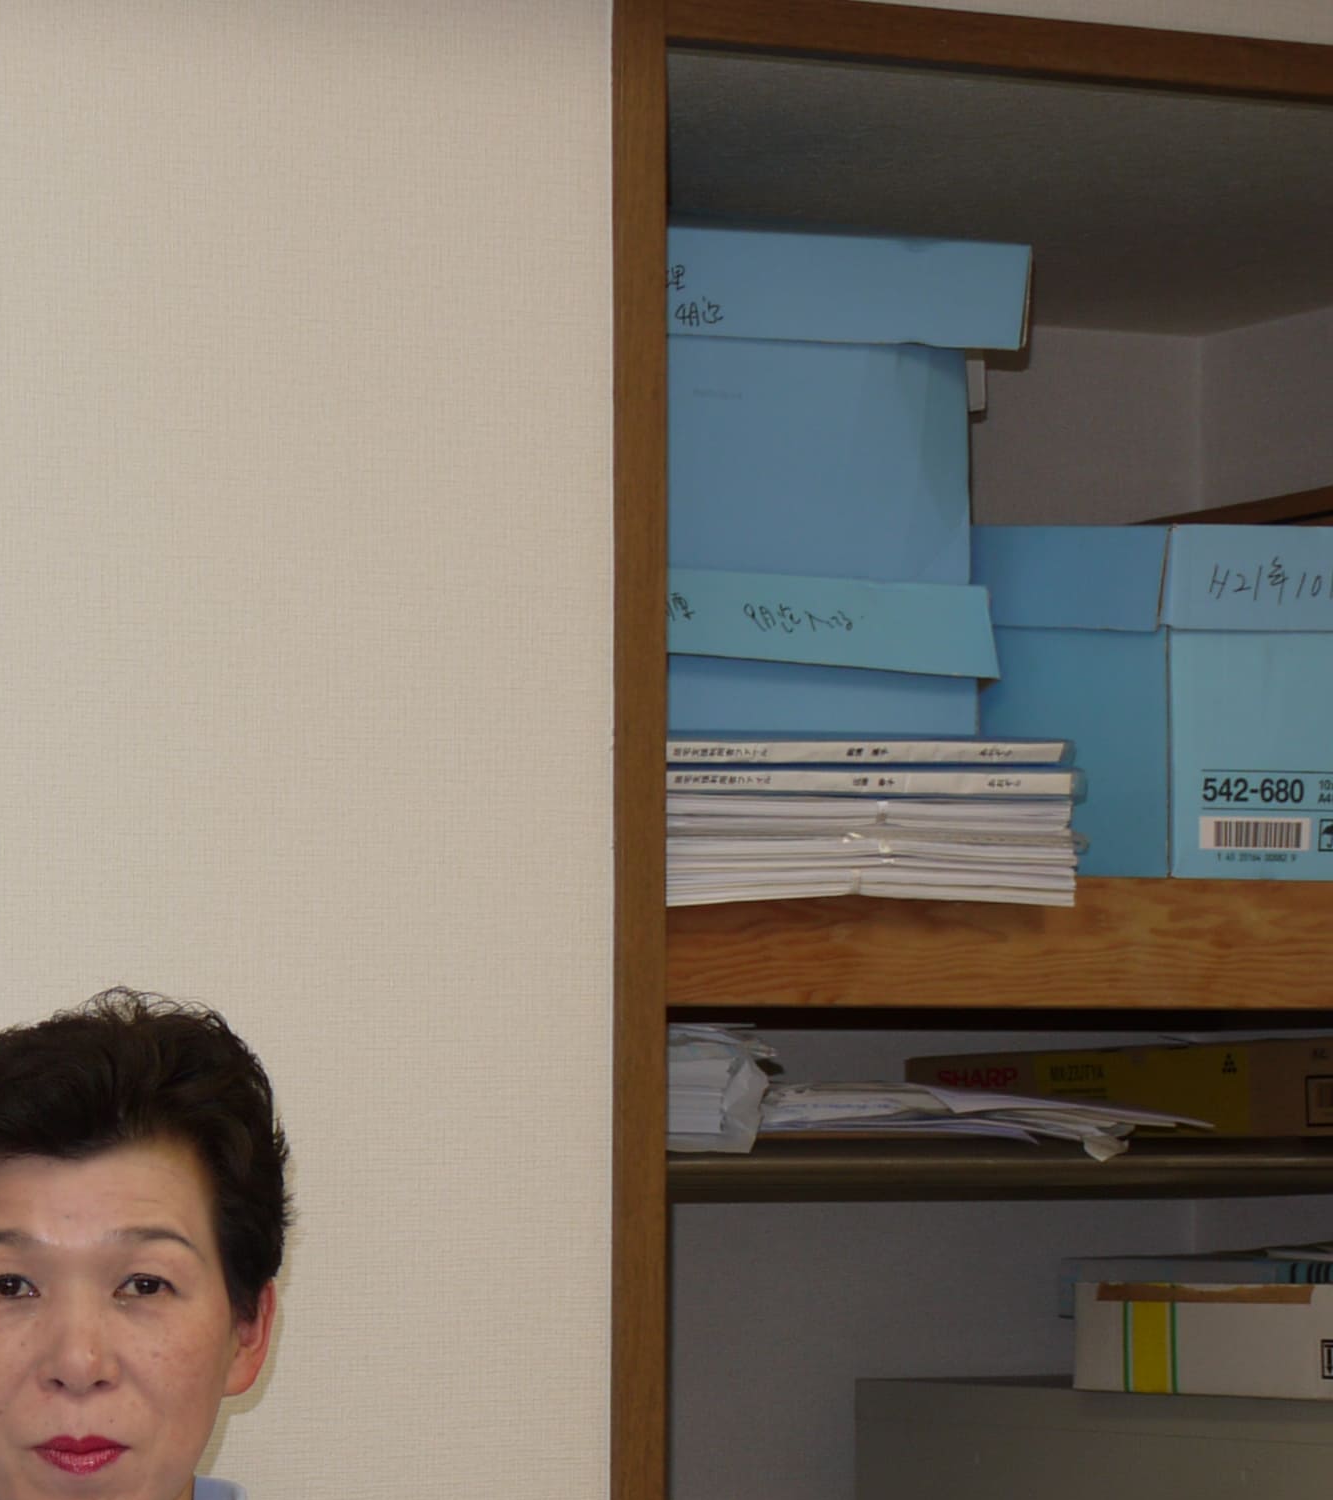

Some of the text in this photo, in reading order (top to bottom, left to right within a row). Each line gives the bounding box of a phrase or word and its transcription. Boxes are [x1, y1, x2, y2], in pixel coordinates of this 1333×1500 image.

[1209, 556, 1333, 606] H21年10
[1202, 777, 1305, 803] 542-680
[937, 1067, 1018, 1088] SHARP
